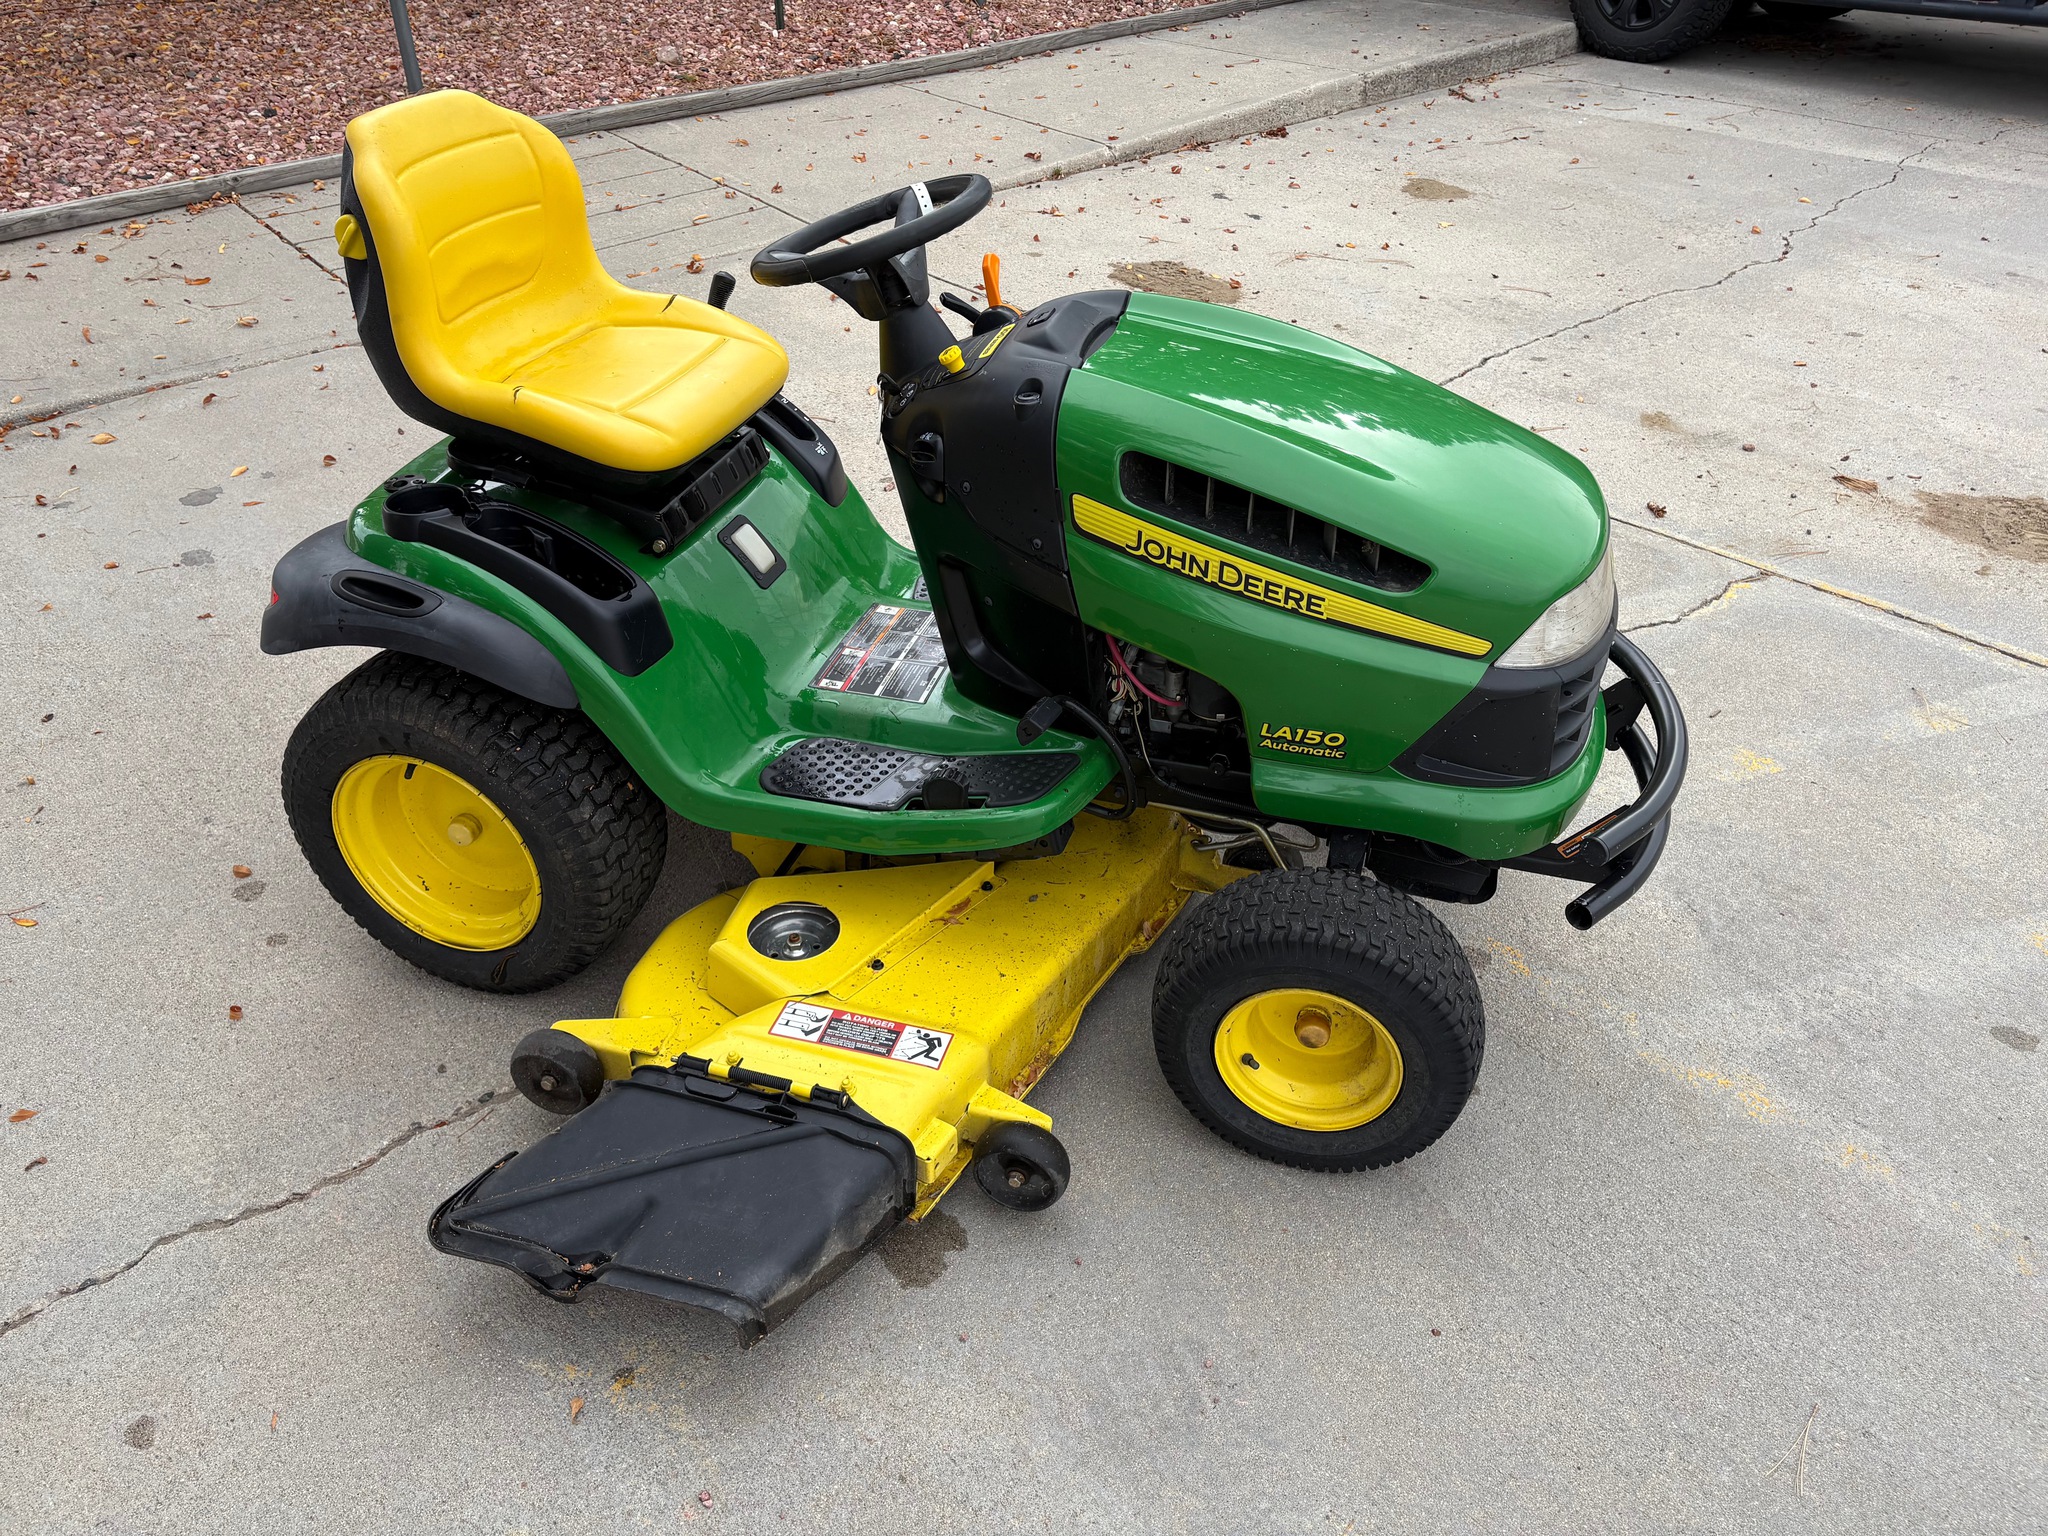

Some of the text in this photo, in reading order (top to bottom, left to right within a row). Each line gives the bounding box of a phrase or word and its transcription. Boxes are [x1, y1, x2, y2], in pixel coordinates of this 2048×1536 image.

[1125, 529, 1327, 616] JOHN DEERE
[1260, 723, 1346, 747] LA150
[1259, 739, 1346, 759] Automatic
[853, 1015, 895, 1029] DANGER
